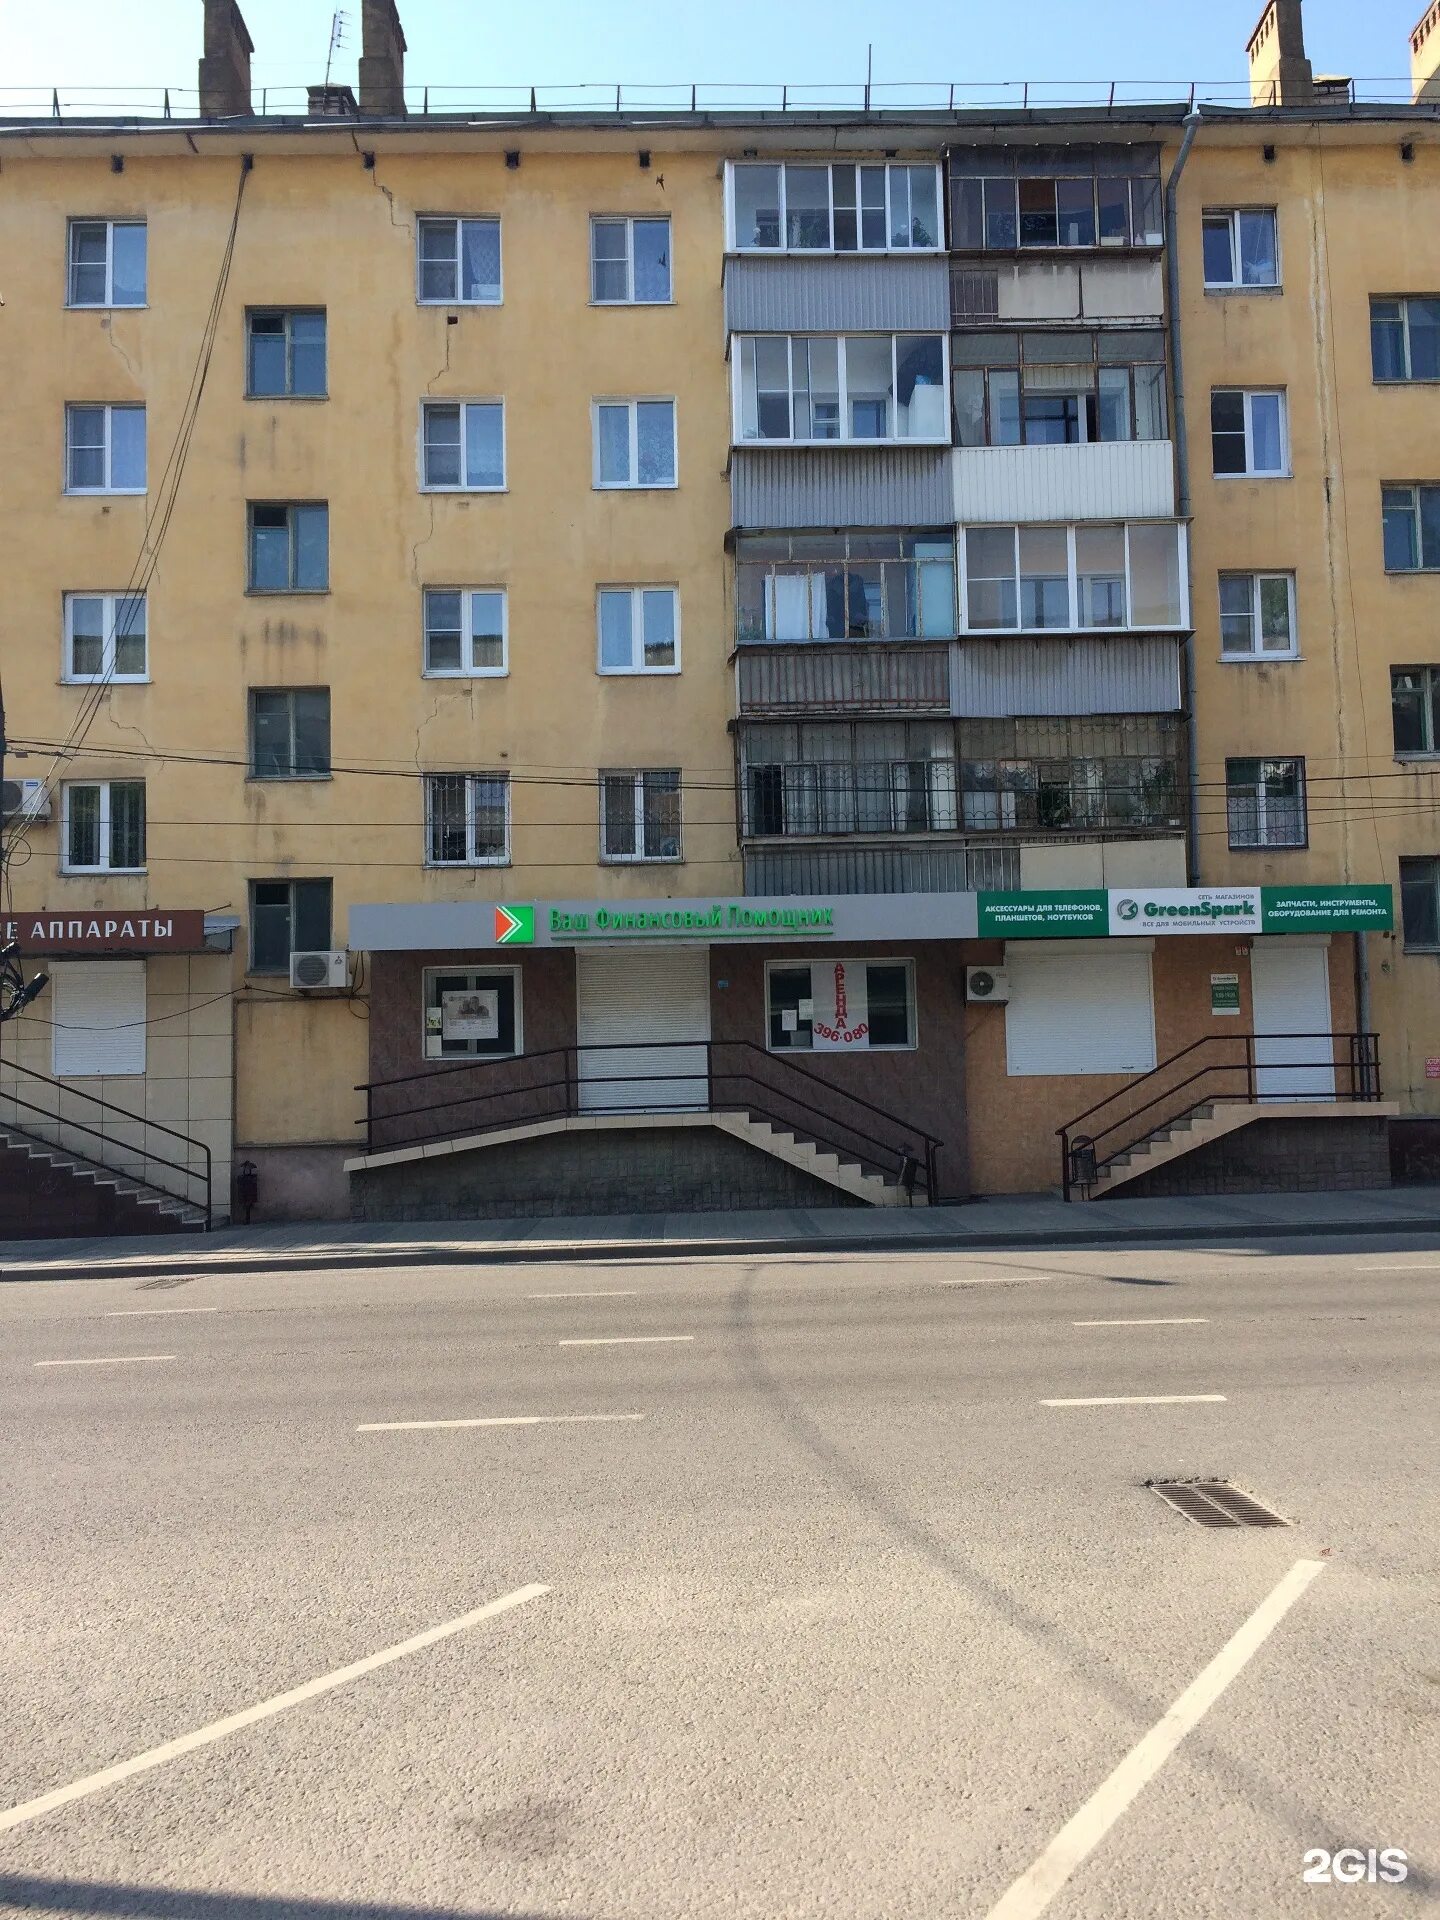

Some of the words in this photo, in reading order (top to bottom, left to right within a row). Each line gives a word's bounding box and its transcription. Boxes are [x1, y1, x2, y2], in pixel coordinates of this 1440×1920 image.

[985, 905, 1035, 913] АКСЕССУАРЫ
[1036, 904, 1053, 913] ДЛЯ
[1054, 904, 1103, 912] ТЕЛЕФОНОВ,
[1144, 900, 1255, 919] GreenSpark
[1276, 900, 1318, 908] ЗАПЧАСТИ,
[1320, 899, 1378, 907] ИНСТРУМЕНТЫ,
[550, 908, 589, 932] Ваш
[595, 904, 722, 931] Финансовый
[727, 903, 833, 930] Помощник
[995, 914, 1045, 922] ПЛАНШЕТОВ,
[1047, 913, 1094, 921] НОУТБУКОВ
[1268, 909, 1332, 917] ОБОРУДОВАНИЕ
[1333, 909, 1349, 917] ДЛЯ
[1351, 908, 1387, 916] РЕМОНТА
[30, 919, 174, 939] АППАРАТЫ
[834, 962, 847, 1029] АРЕНДА
